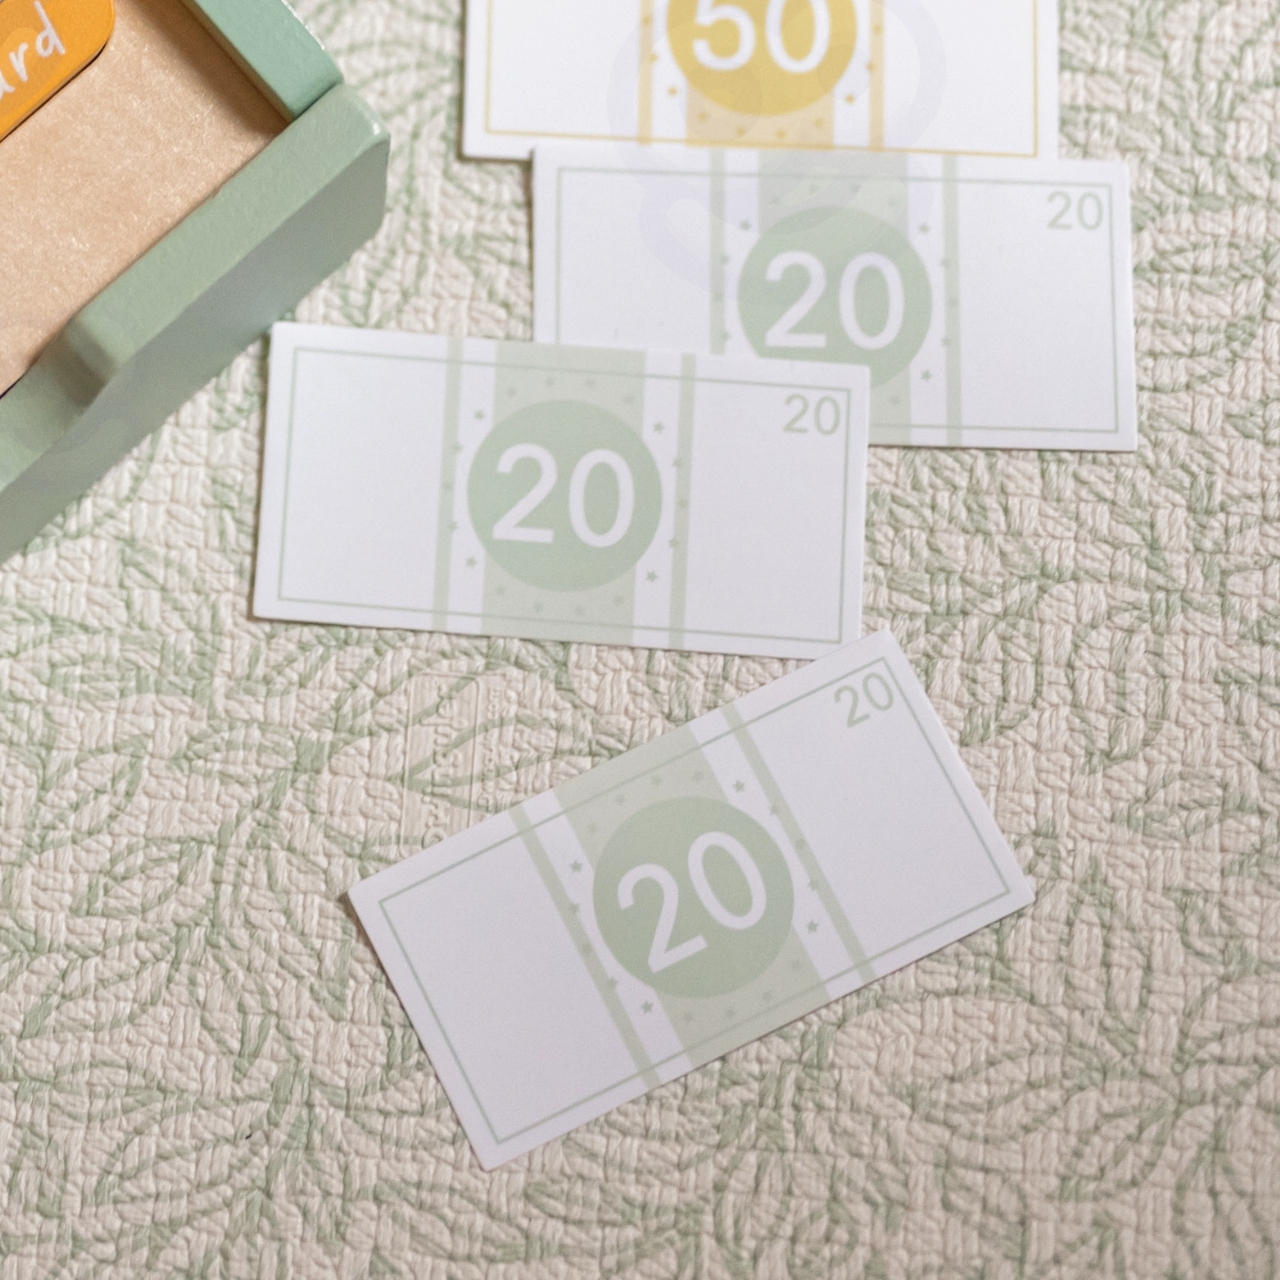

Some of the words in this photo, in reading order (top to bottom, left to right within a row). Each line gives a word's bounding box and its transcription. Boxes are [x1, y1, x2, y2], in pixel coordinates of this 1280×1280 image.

[1045, 190, 1105, 232] 20
[762, 250, 906, 351] 20
[782, 393, 843, 436] 20
[490, 442, 636, 549] 20
[833, 670, 896, 729] 20
[616, 829, 769, 976] 20
